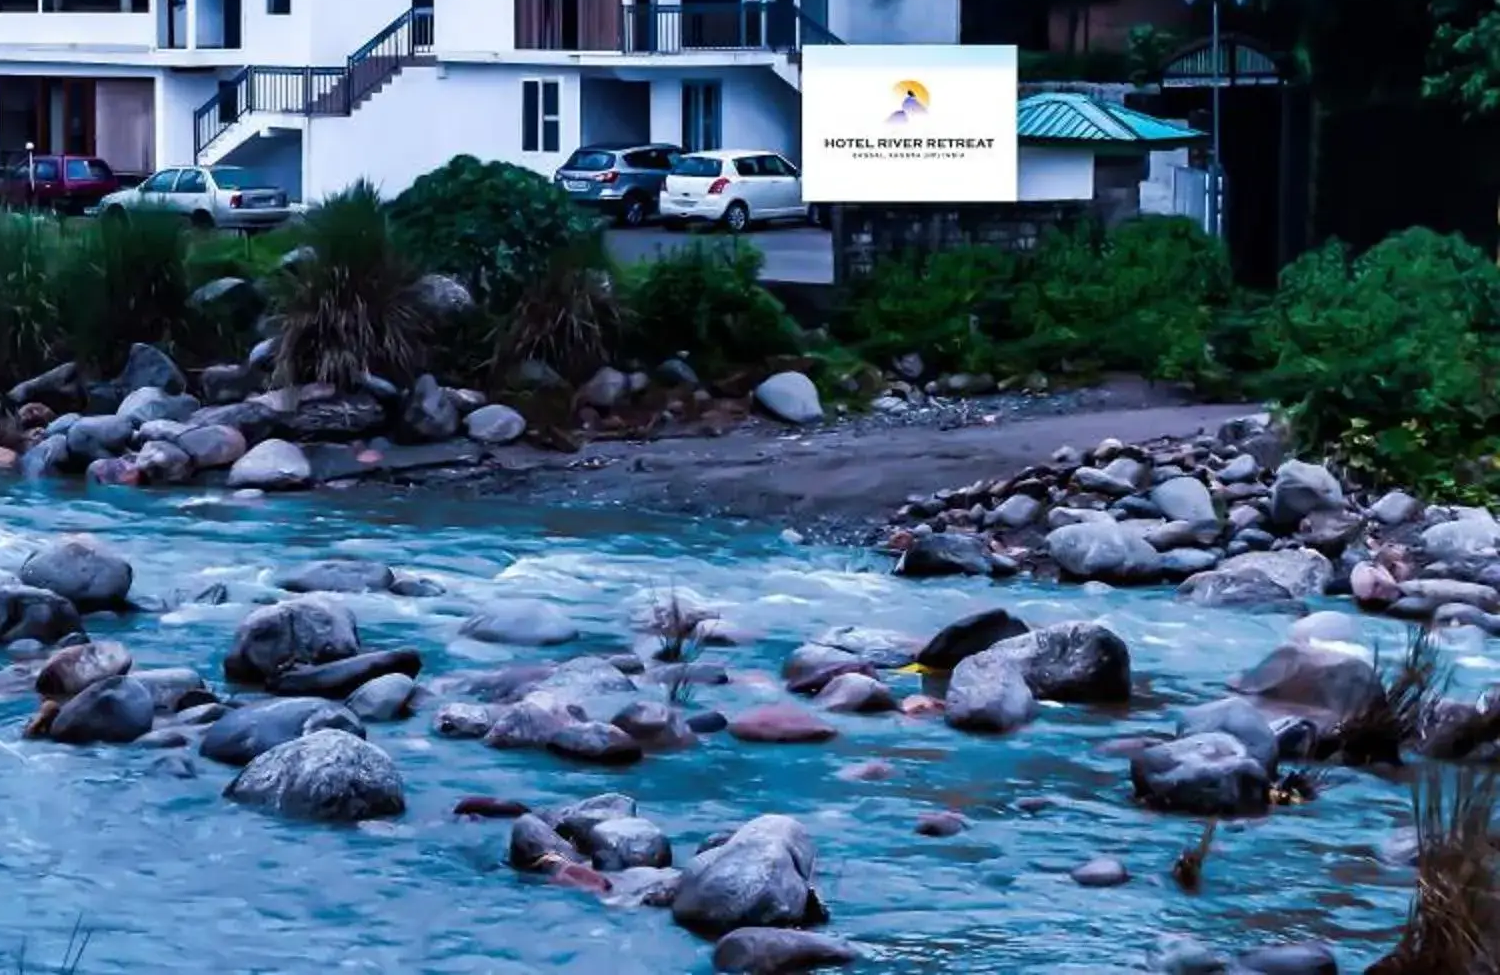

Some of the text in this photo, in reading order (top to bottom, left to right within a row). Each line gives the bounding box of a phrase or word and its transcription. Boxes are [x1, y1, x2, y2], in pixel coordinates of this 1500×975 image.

[824, 138, 995, 149] HOTEL RIVER RETREAT
